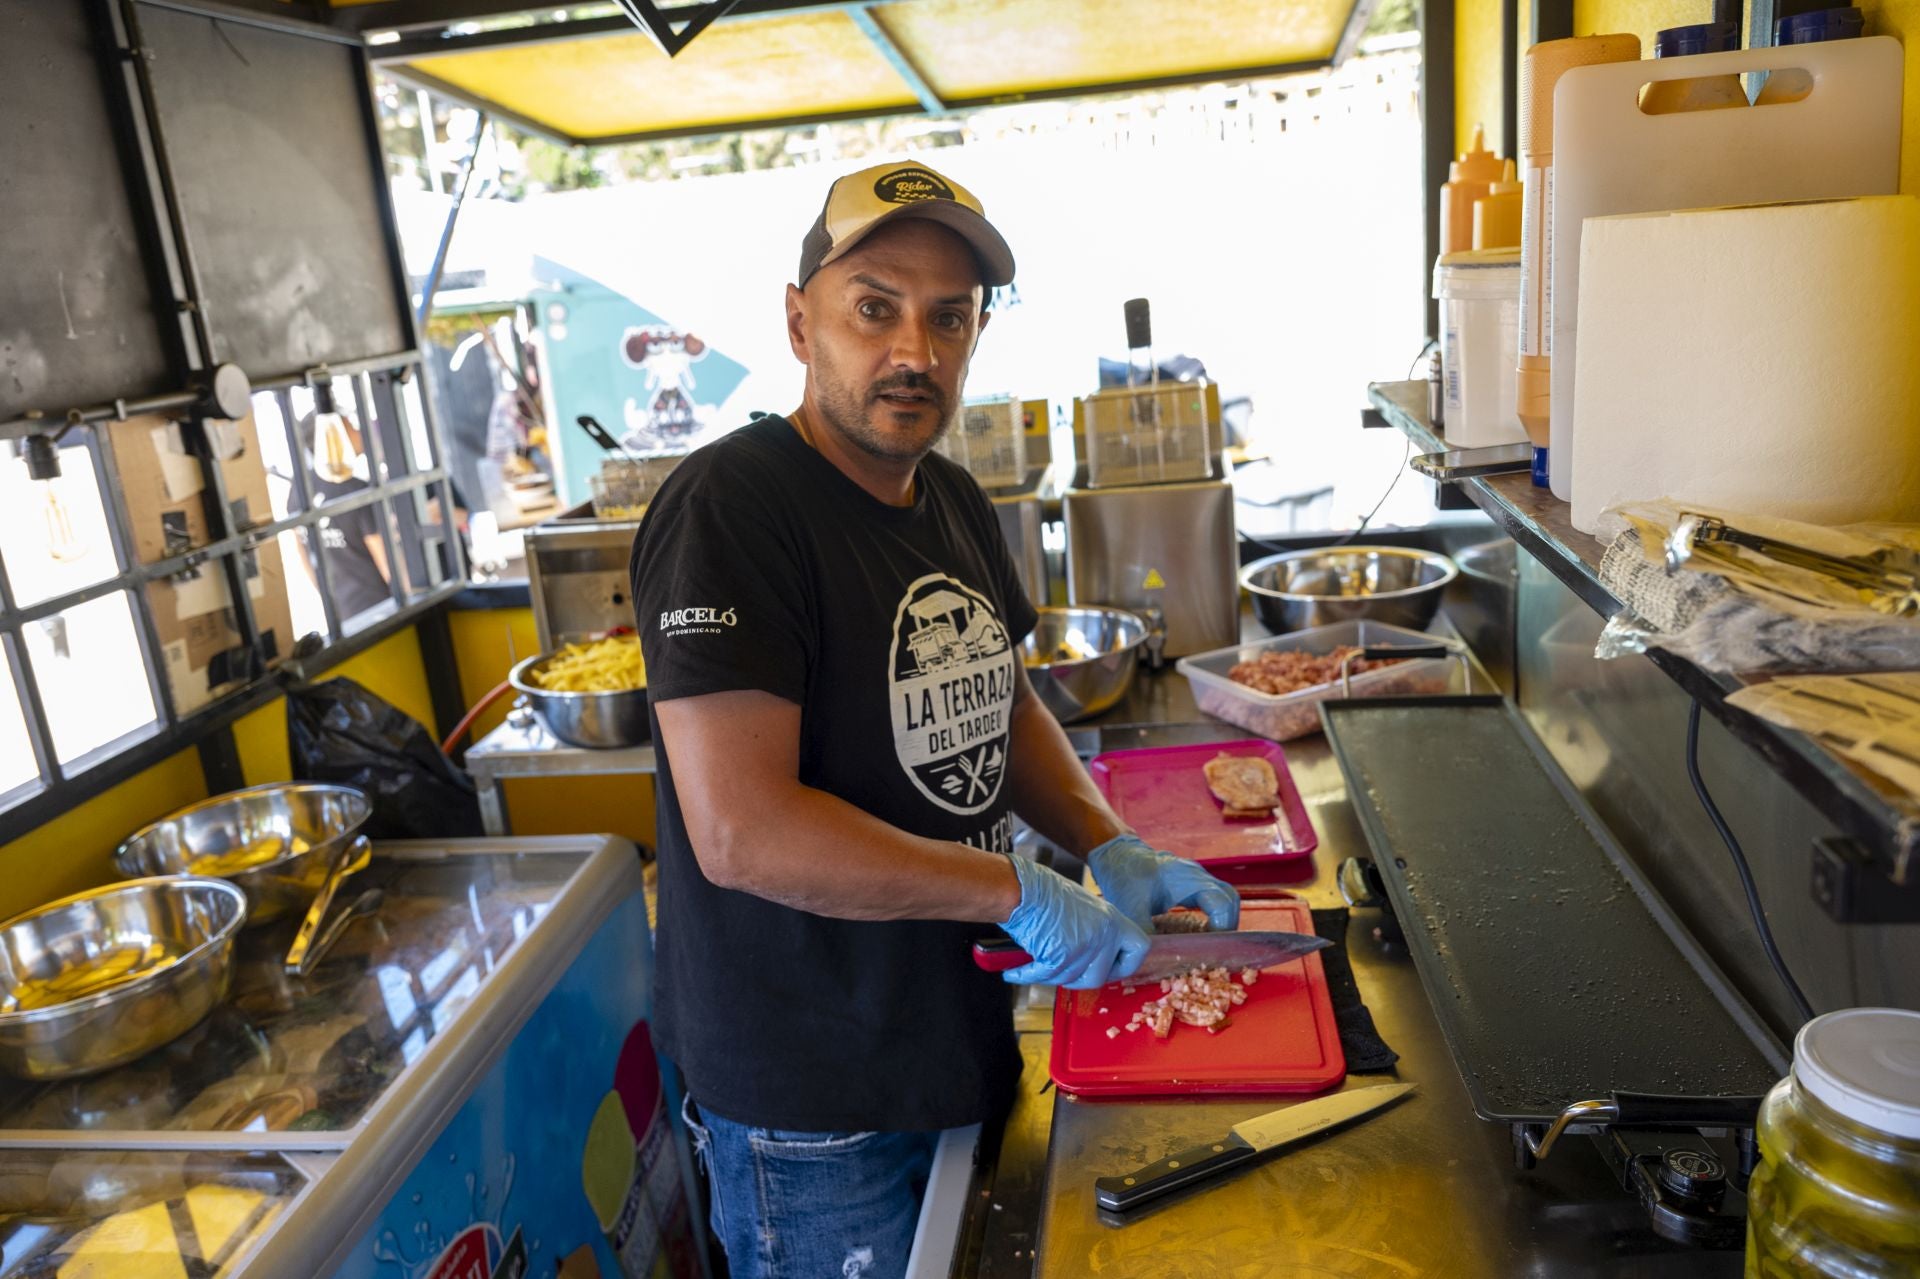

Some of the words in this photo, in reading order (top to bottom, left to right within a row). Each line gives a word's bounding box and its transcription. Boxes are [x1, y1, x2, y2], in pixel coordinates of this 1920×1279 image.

[896, 181, 933, 191] Rider
[660, 607, 738, 630] BARCELÓ
[904, 687, 936, 731] LA
[929, 727, 956, 754] DEL
